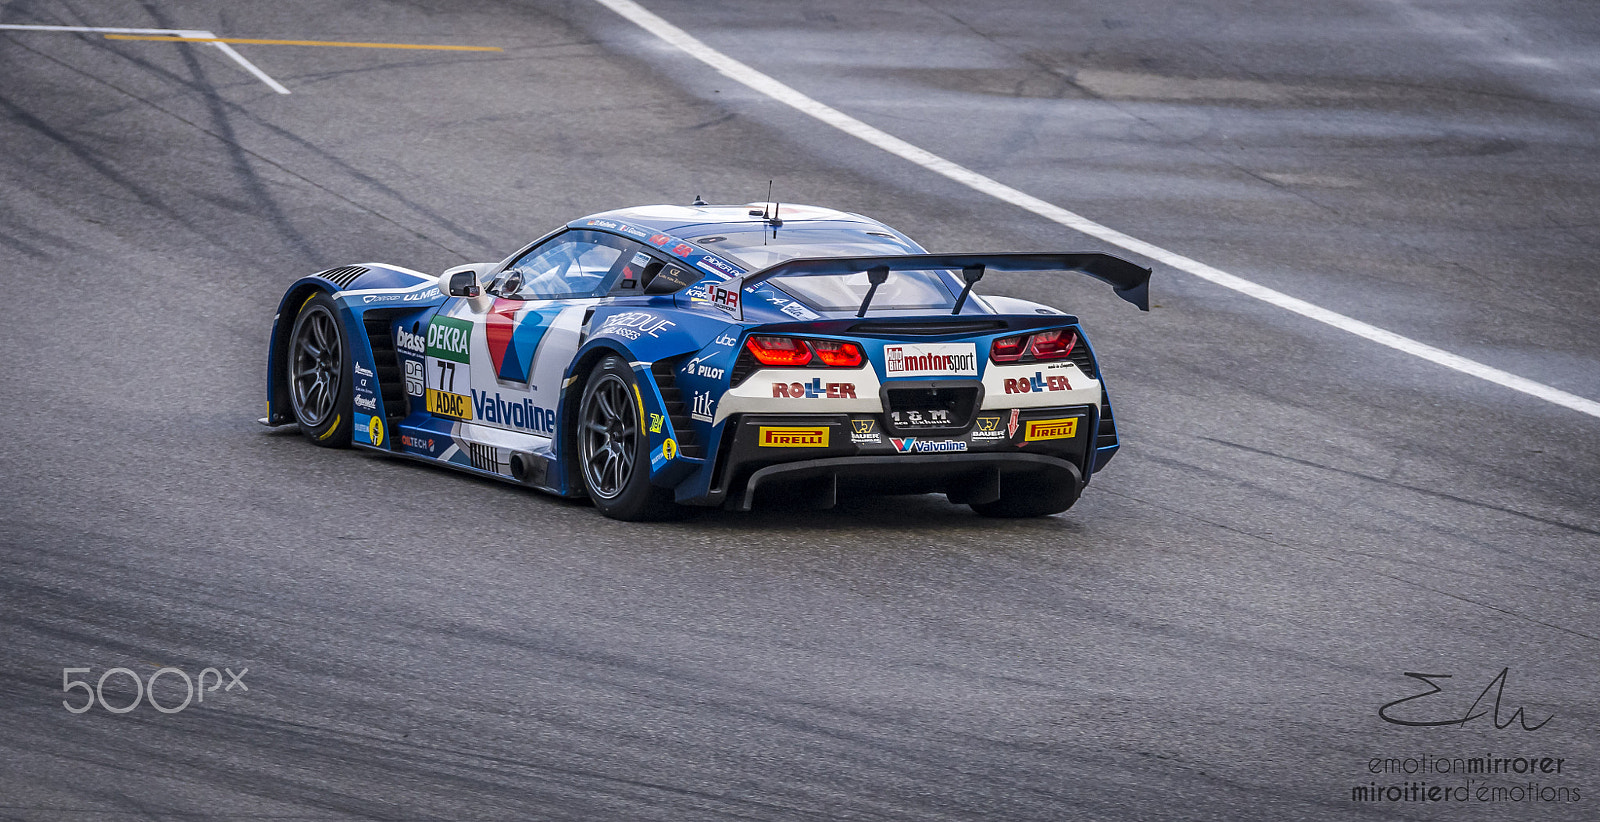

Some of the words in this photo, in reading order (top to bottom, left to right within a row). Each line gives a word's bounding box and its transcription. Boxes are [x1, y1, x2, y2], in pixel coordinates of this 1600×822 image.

[397, 326, 426, 353] brass
[428, 323, 469, 355] DEKRA
[715, 333, 737, 347] ubc
[697, 366, 725, 380] PILOT
[904, 352, 975, 374] motorsport
[437, 360, 456, 392] 77
[1003, 371, 1073, 395] ROLLER
[772, 377, 858, 399] ROLLER
[435, 392, 464, 417] ADAC
[471, 388, 555, 434] Valvoline
[692, 390, 715, 417] itk
[765, 430, 823, 444] PIRELLI
[972, 430, 1005, 438] BAUER
[1030, 421, 1073, 438] PIRELLI
[401, 435, 428, 450] OILTECH
[915, 440, 968, 453] Valvoline
